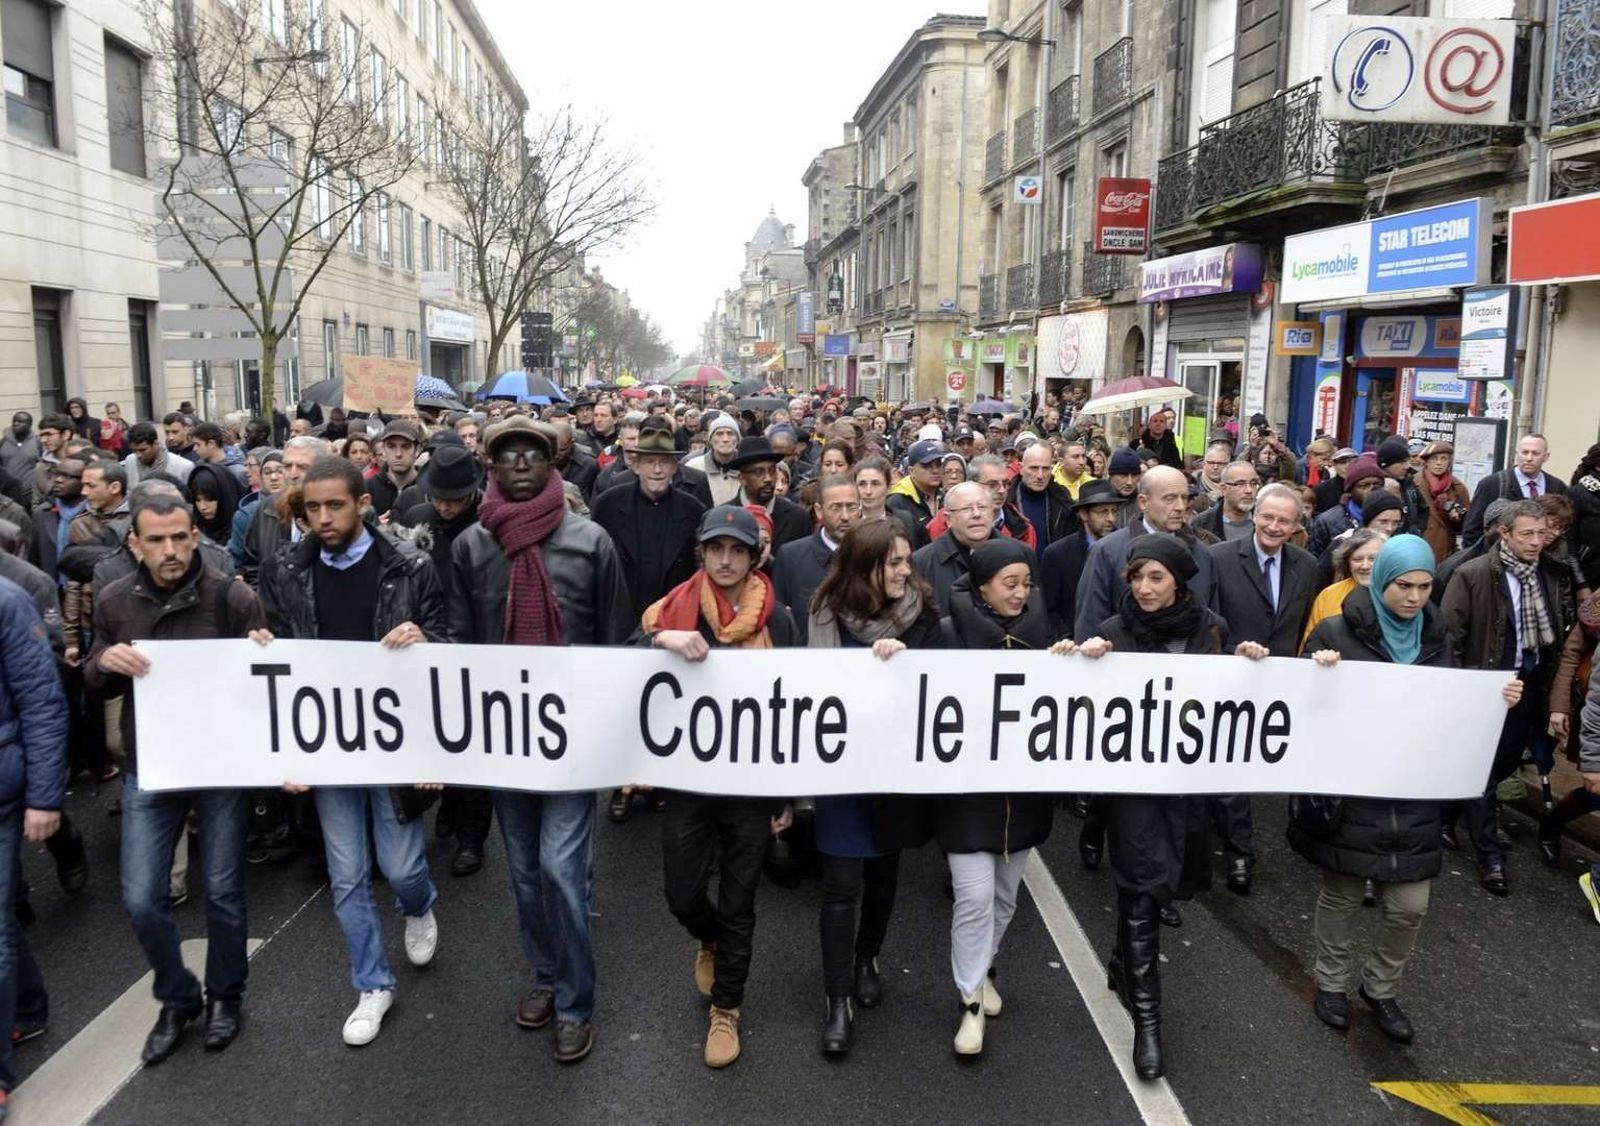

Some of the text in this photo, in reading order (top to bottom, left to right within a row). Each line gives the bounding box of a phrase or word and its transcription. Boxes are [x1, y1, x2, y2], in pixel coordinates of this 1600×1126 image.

[1103, 238, 1144, 248] ONCLE SAM
[1378, 217, 1470, 252] STAR TELECOM
[1292, 253, 1358, 280] Lycamobile
[1469, 304, 1502, 317] Victoire
[1285, 328, 1312, 344] Ria
[1376, 321, 1413, 341] TAXI
[1419, 381, 1463, 393] Lycamobile
[251, 663, 1291, 765] Tous Unis Contre le Fanatisme
